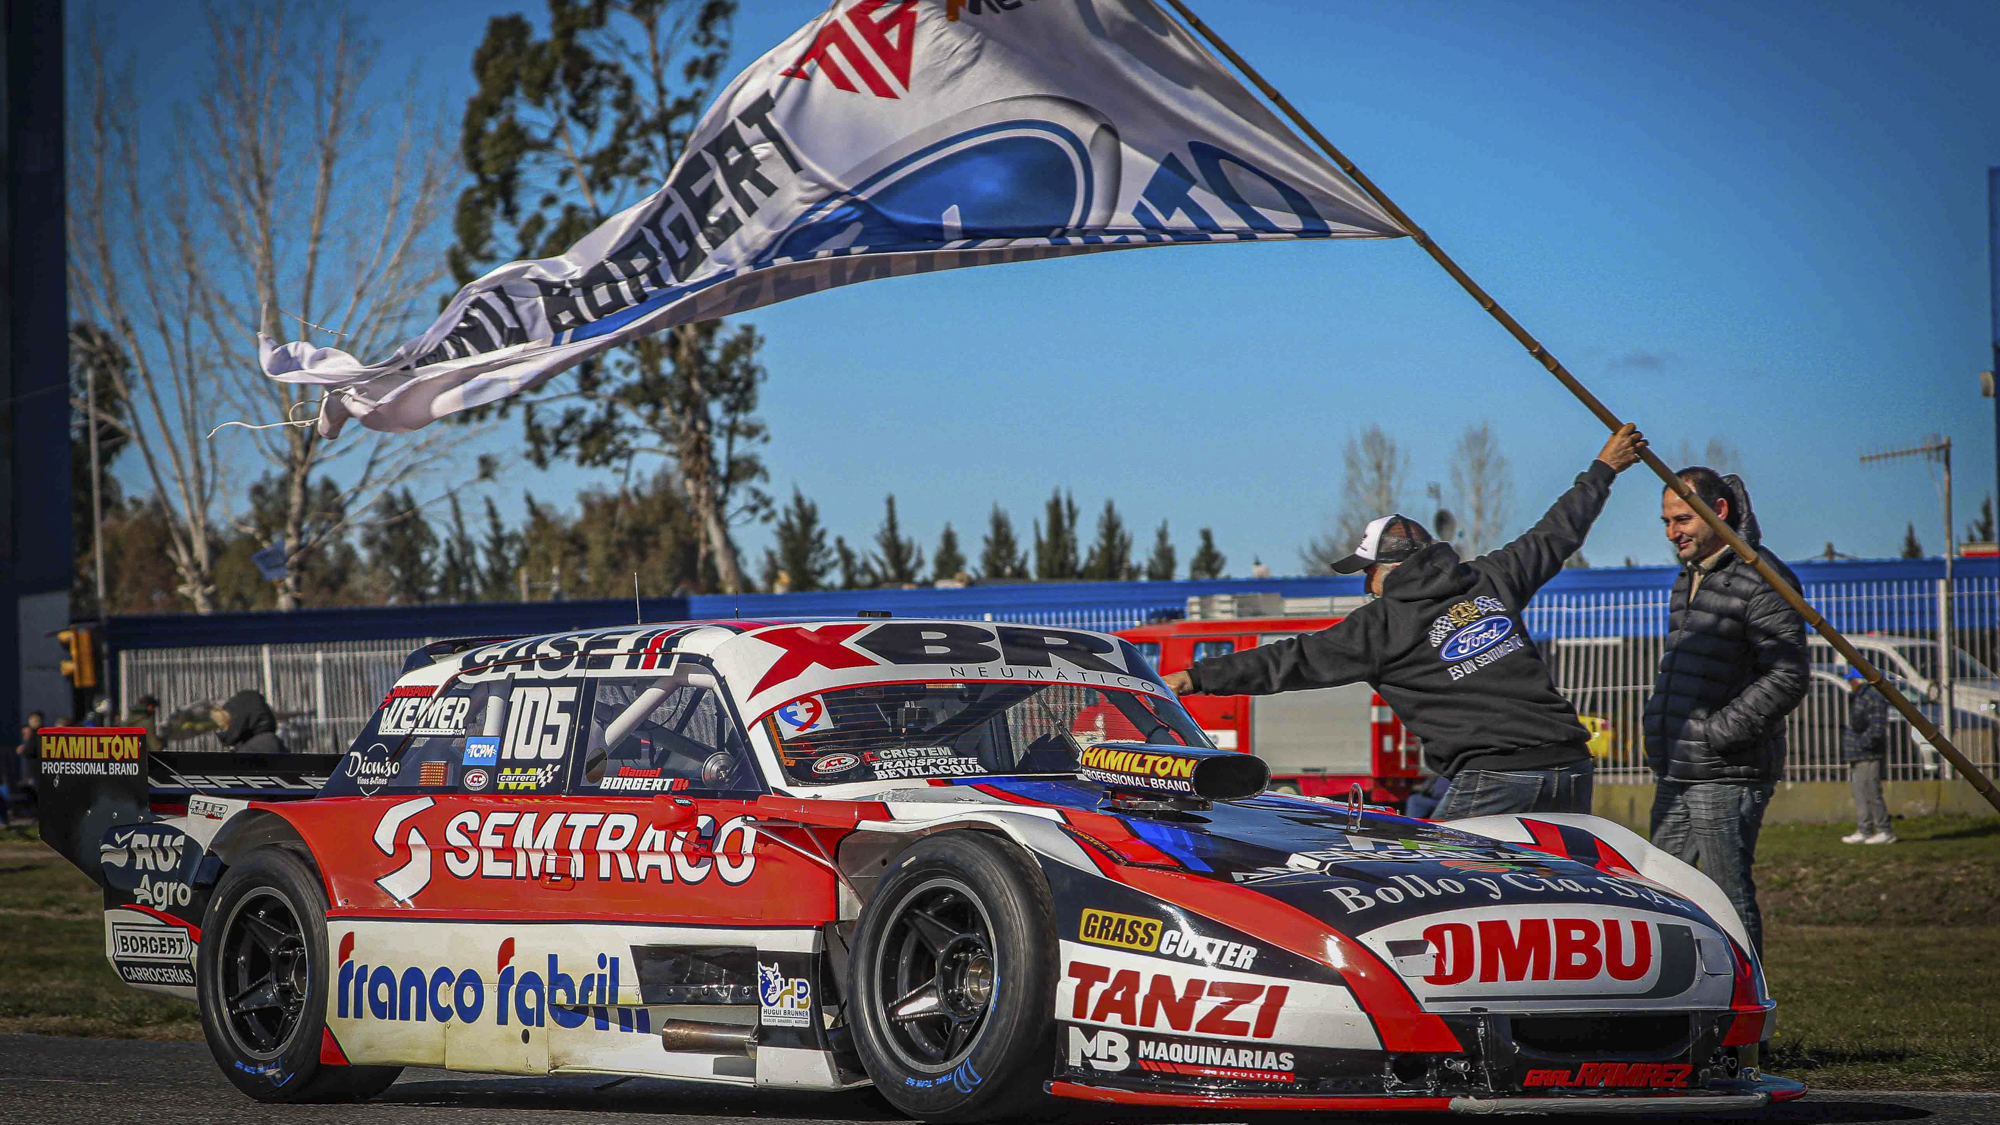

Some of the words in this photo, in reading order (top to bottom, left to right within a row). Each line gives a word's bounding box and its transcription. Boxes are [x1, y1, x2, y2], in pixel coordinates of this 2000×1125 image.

[536, 90, 803, 337] BORGERT
[1457, 622, 1501, 654] Ford
[460, 632, 633, 676] CASE
[748, 623, 1130, 701] XBR
[1448, 664, 1464, 681] ES
[1463, 660, 1478, 675] UN
[501, 686, 577, 760] 105
[41, 735, 139, 761] HAMILTON
[468, 744, 495, 758] TCPM
[880, 747, 952, 760] CRISTEM
[1081, 746, 1197, 778] HAMILTON
[41, 762, 107, 775] PROFESSIONAL
[109, 763, 139, 776] BRAND
[499, 774, 536, 782] carrera
[617, 766, 663, 778] Manuel
[872, 757, 978, 771] TRANSPORTE
[873, 764, 989, 780] BEVILACQUA
[600, 776, 674, 791] BORGERT
[1082, 769, 1150, 788] PROFESSIONAL
[1151, 778, 1191, 792] BRAND
[445, 810, 761, 885] SEMTRACO
[134, 874, 192, 911] Agro
[1324, 873, 1467, 915] Bollo
[1083, 913, 1158, 947] GRASS
[119, 935, 185, 955] BORGERT
[1421, 918, 1653, 985] OMBU
[122, 965, 194, 984] CARROCERÍAS
[337, 931, 485, 1025] franco
[496, 936, 651, 1034] fabril
[763, 1008, 782, 1016] HUGUI
[783, 1009, 809, 1018] BRUNNER
[1067, 960, 1291, 1039] TANZI
[1068, 1026, 1131, 1073] MB
[1138, 1039, 1295, 1072] MAQUINARIAS
[1572, 1062, 1694, 1088] RAMIREZ
